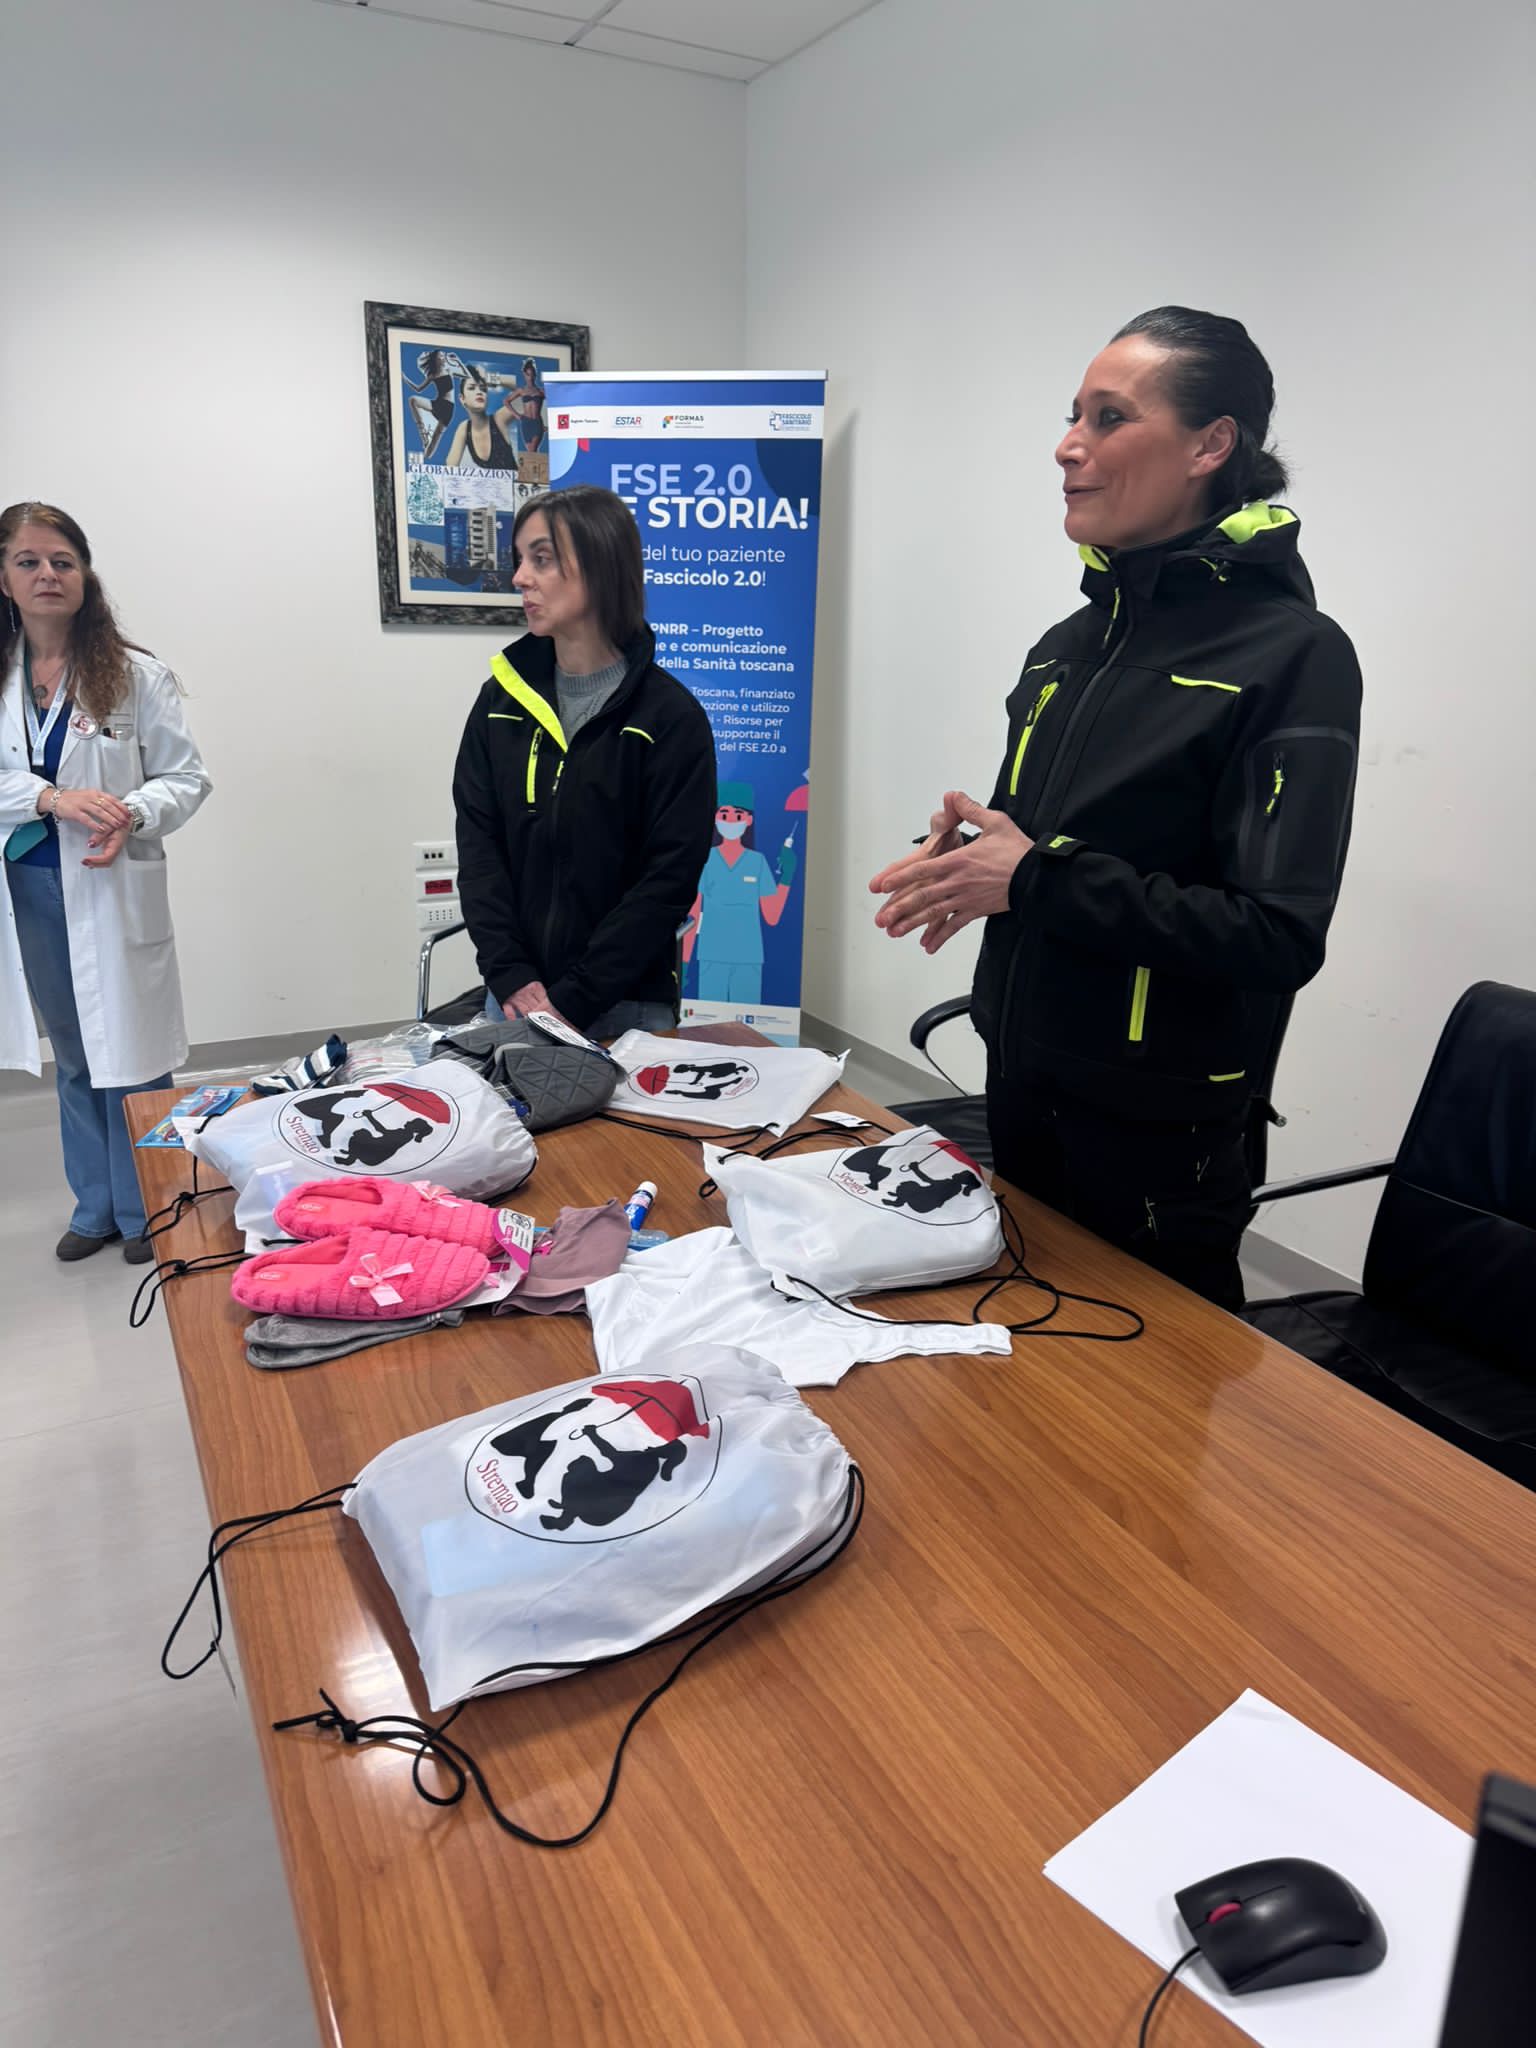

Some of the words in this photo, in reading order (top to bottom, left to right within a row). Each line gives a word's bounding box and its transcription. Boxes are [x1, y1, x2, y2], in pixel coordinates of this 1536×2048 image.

[615, 416, 642, 426] ESTAR
[611, 463, 681, 496] FSE
[693, 463, 752, 497] 2.0
[648, 496, 809, 530] STORIA!
[642, 544, 666, 561] del
[671, 546, 702, 561] tuo
[707, 545, 786, 566] paziente
[643, 568, 729, 586] Fascicolo
[733, 570, 767, 587] 2.0!
[650, 622, 689, 635] PNRR
[702, 624, 764, 639] Progetto
[670, 642, 678, 652] e
[681, 641, 787, 655] comunicazione
[657, 656, 690, 669] della
[693, 657, 736, 670] Sanità
[740, 659, 794, 672] toscana
[691, 687, 738, 698] Toscana,
[740, 687, 796, 700] finanziato
[741, 703, 749, 712] e
[751, 702, 790, 713] utilizzo
[723, 715, 762, 725] Risorse
[764, 718, 783, 728] per
[712, 730, 771, 740] supportare
[774, 730, 780, 740] il
[719, 742, 736, 751] del
[739, 743, 759, 753] FSE
[761, 743, 777, 753] 2.0
[780, 745, 787, 754] a
[476, 1458, 519, 1514] Stremao
